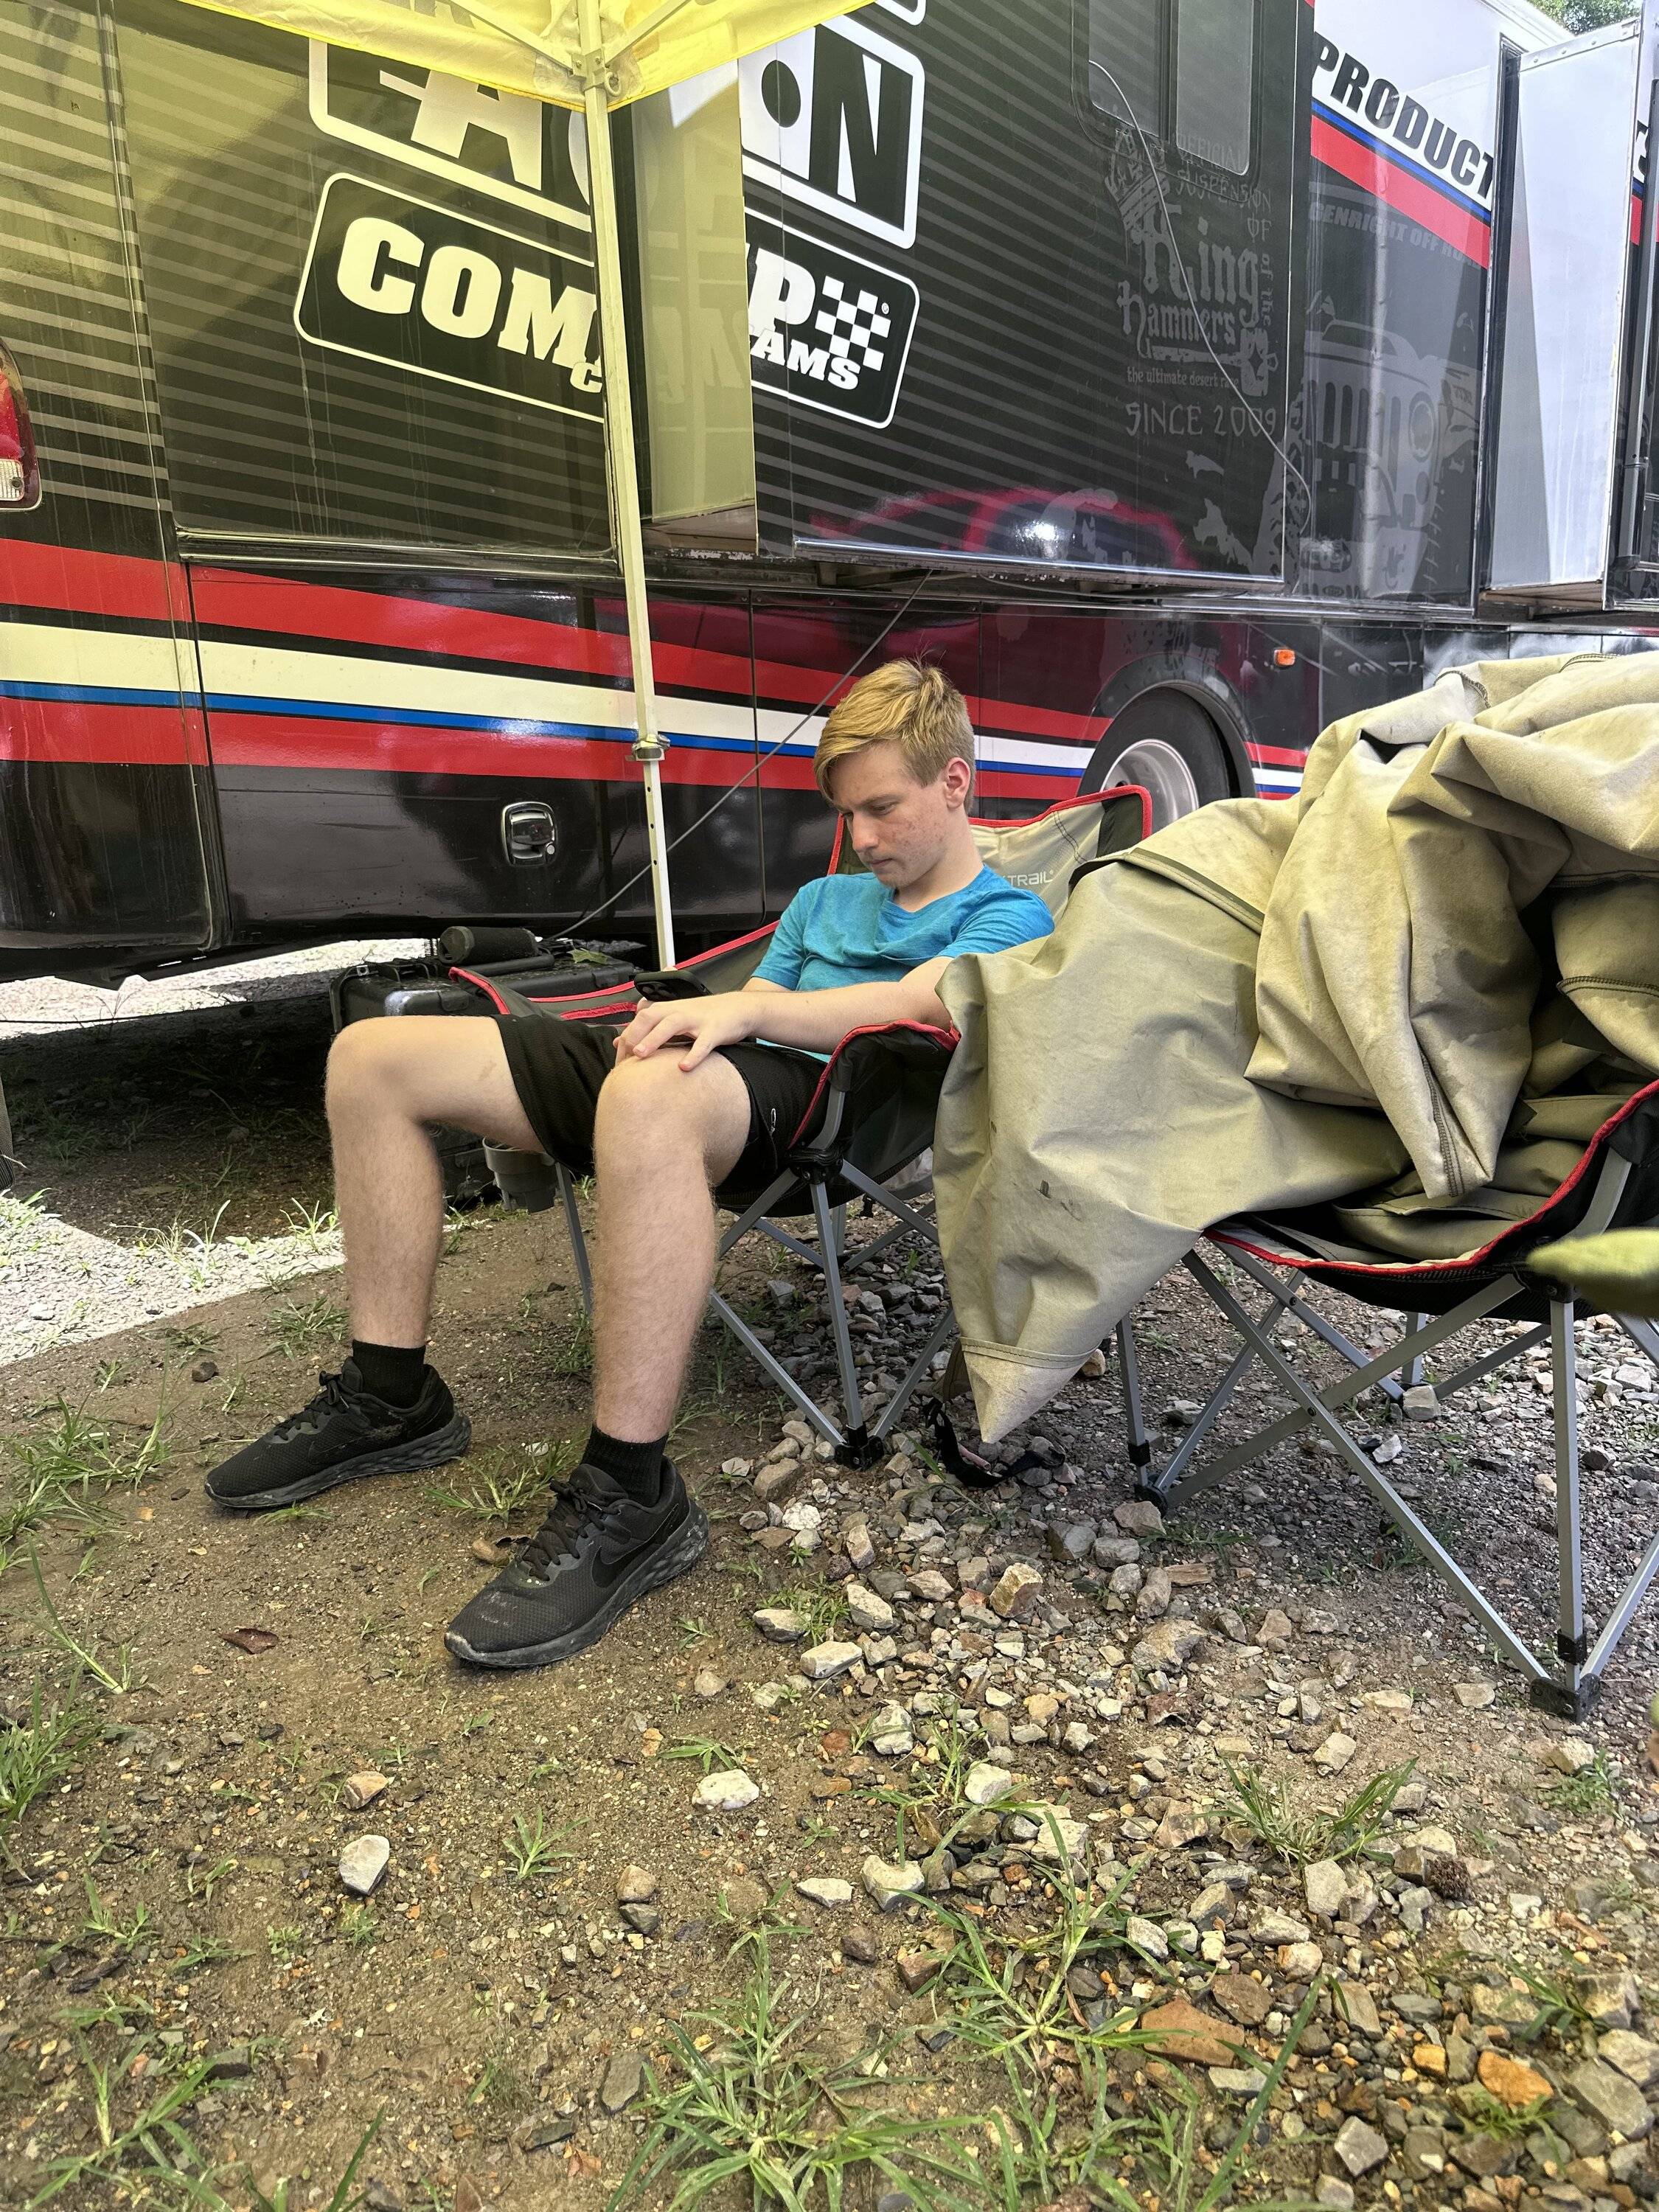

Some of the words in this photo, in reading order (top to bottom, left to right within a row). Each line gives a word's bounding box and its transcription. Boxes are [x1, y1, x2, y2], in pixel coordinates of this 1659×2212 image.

[1175, 166, 1272, 214] SUSPENSION
[1247, 212, 1273, 243] OF
[1130, 203, 1259, 328] King
[1127, 366, 1144, 383] the
[1146, 367, 1187, 386] ultimate
[1189, 370, 1218, 388] desert
[1220, 375, 1239, 389] rae
[1125, 401, 1203, 437] SINCE
[1213, 406, 1277, 437] 2009
